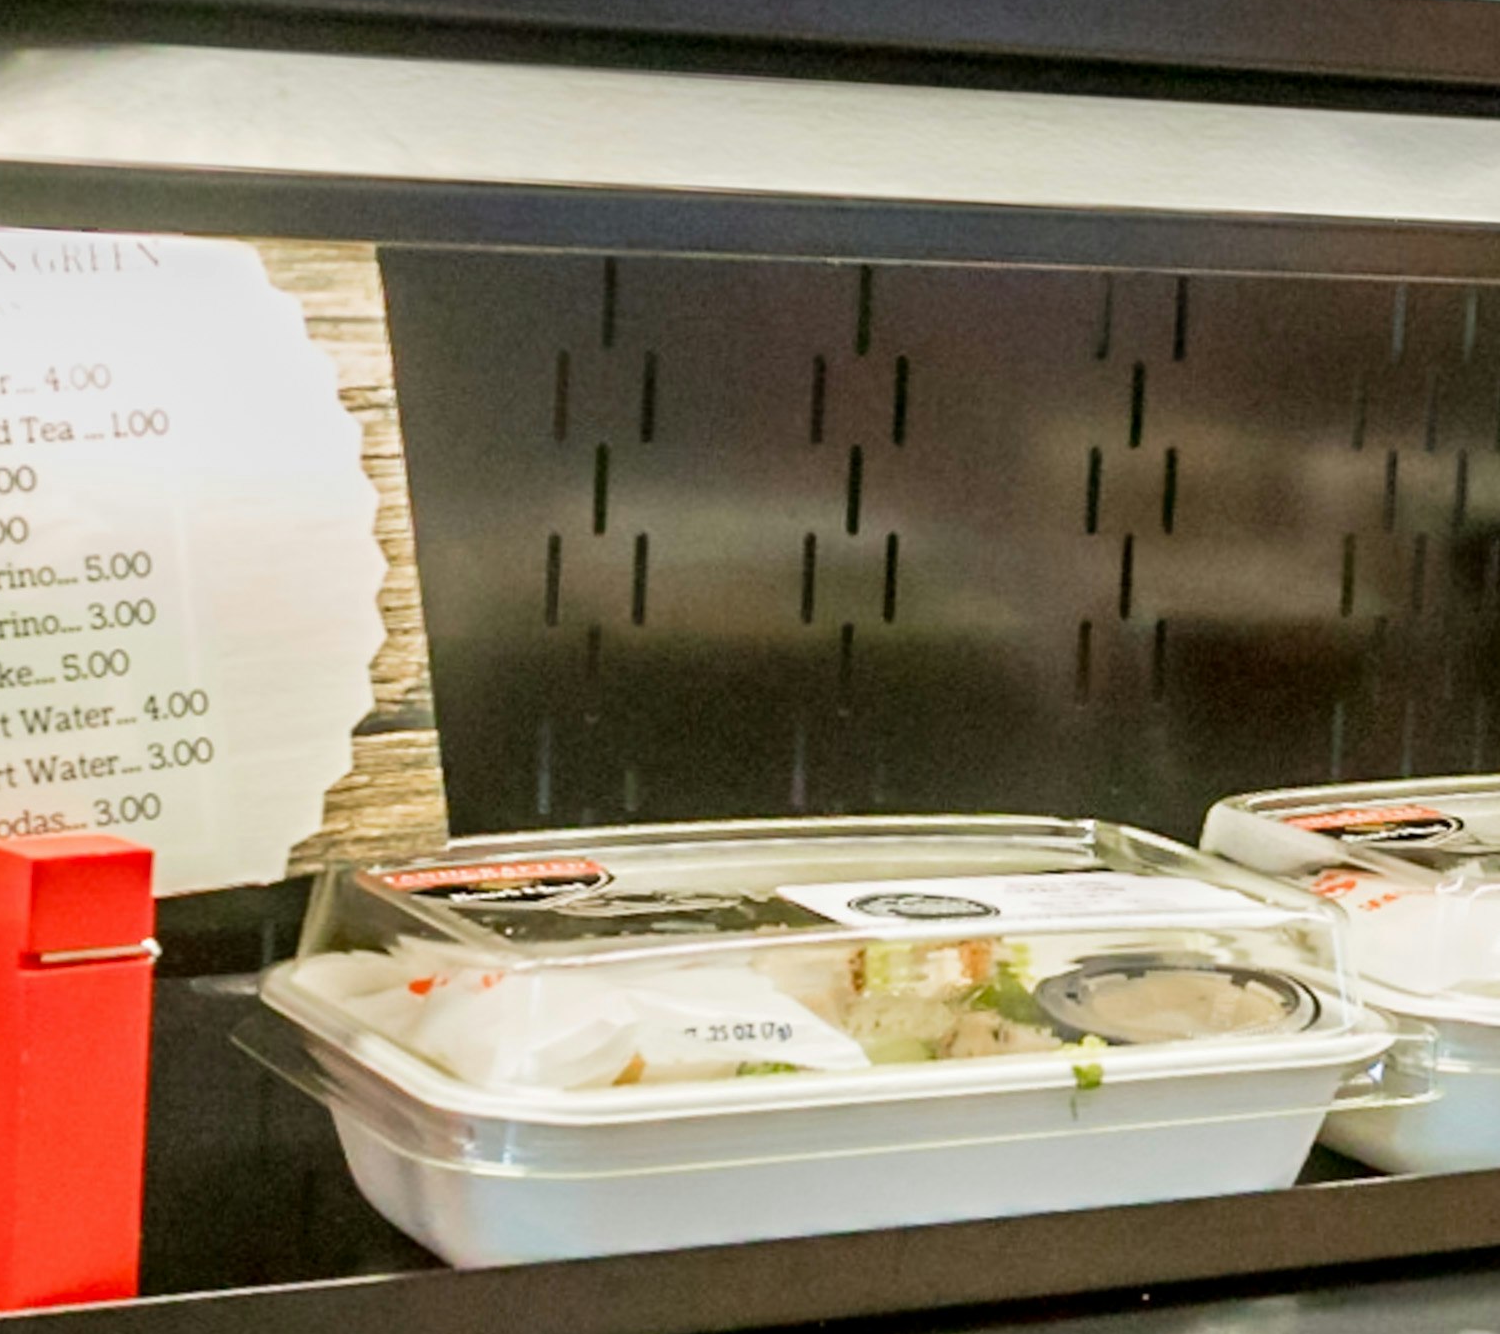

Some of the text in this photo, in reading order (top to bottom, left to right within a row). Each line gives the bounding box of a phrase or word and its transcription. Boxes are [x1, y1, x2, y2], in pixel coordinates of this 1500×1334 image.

[44, 363, 113, 394] 4.00
[18, 416, 76, 445] Tea
[111, 408, 170, 441] 1.00
[85, 550, 153, 583] 5.00
[87, 598, 157, 632] 3.00
[61, 648, 131, 683] 5.00
[143, 688, 210, 722] 4.00
[148, 736, 215, 771] 3.00
[93, 792, 162, 828] 3.00
